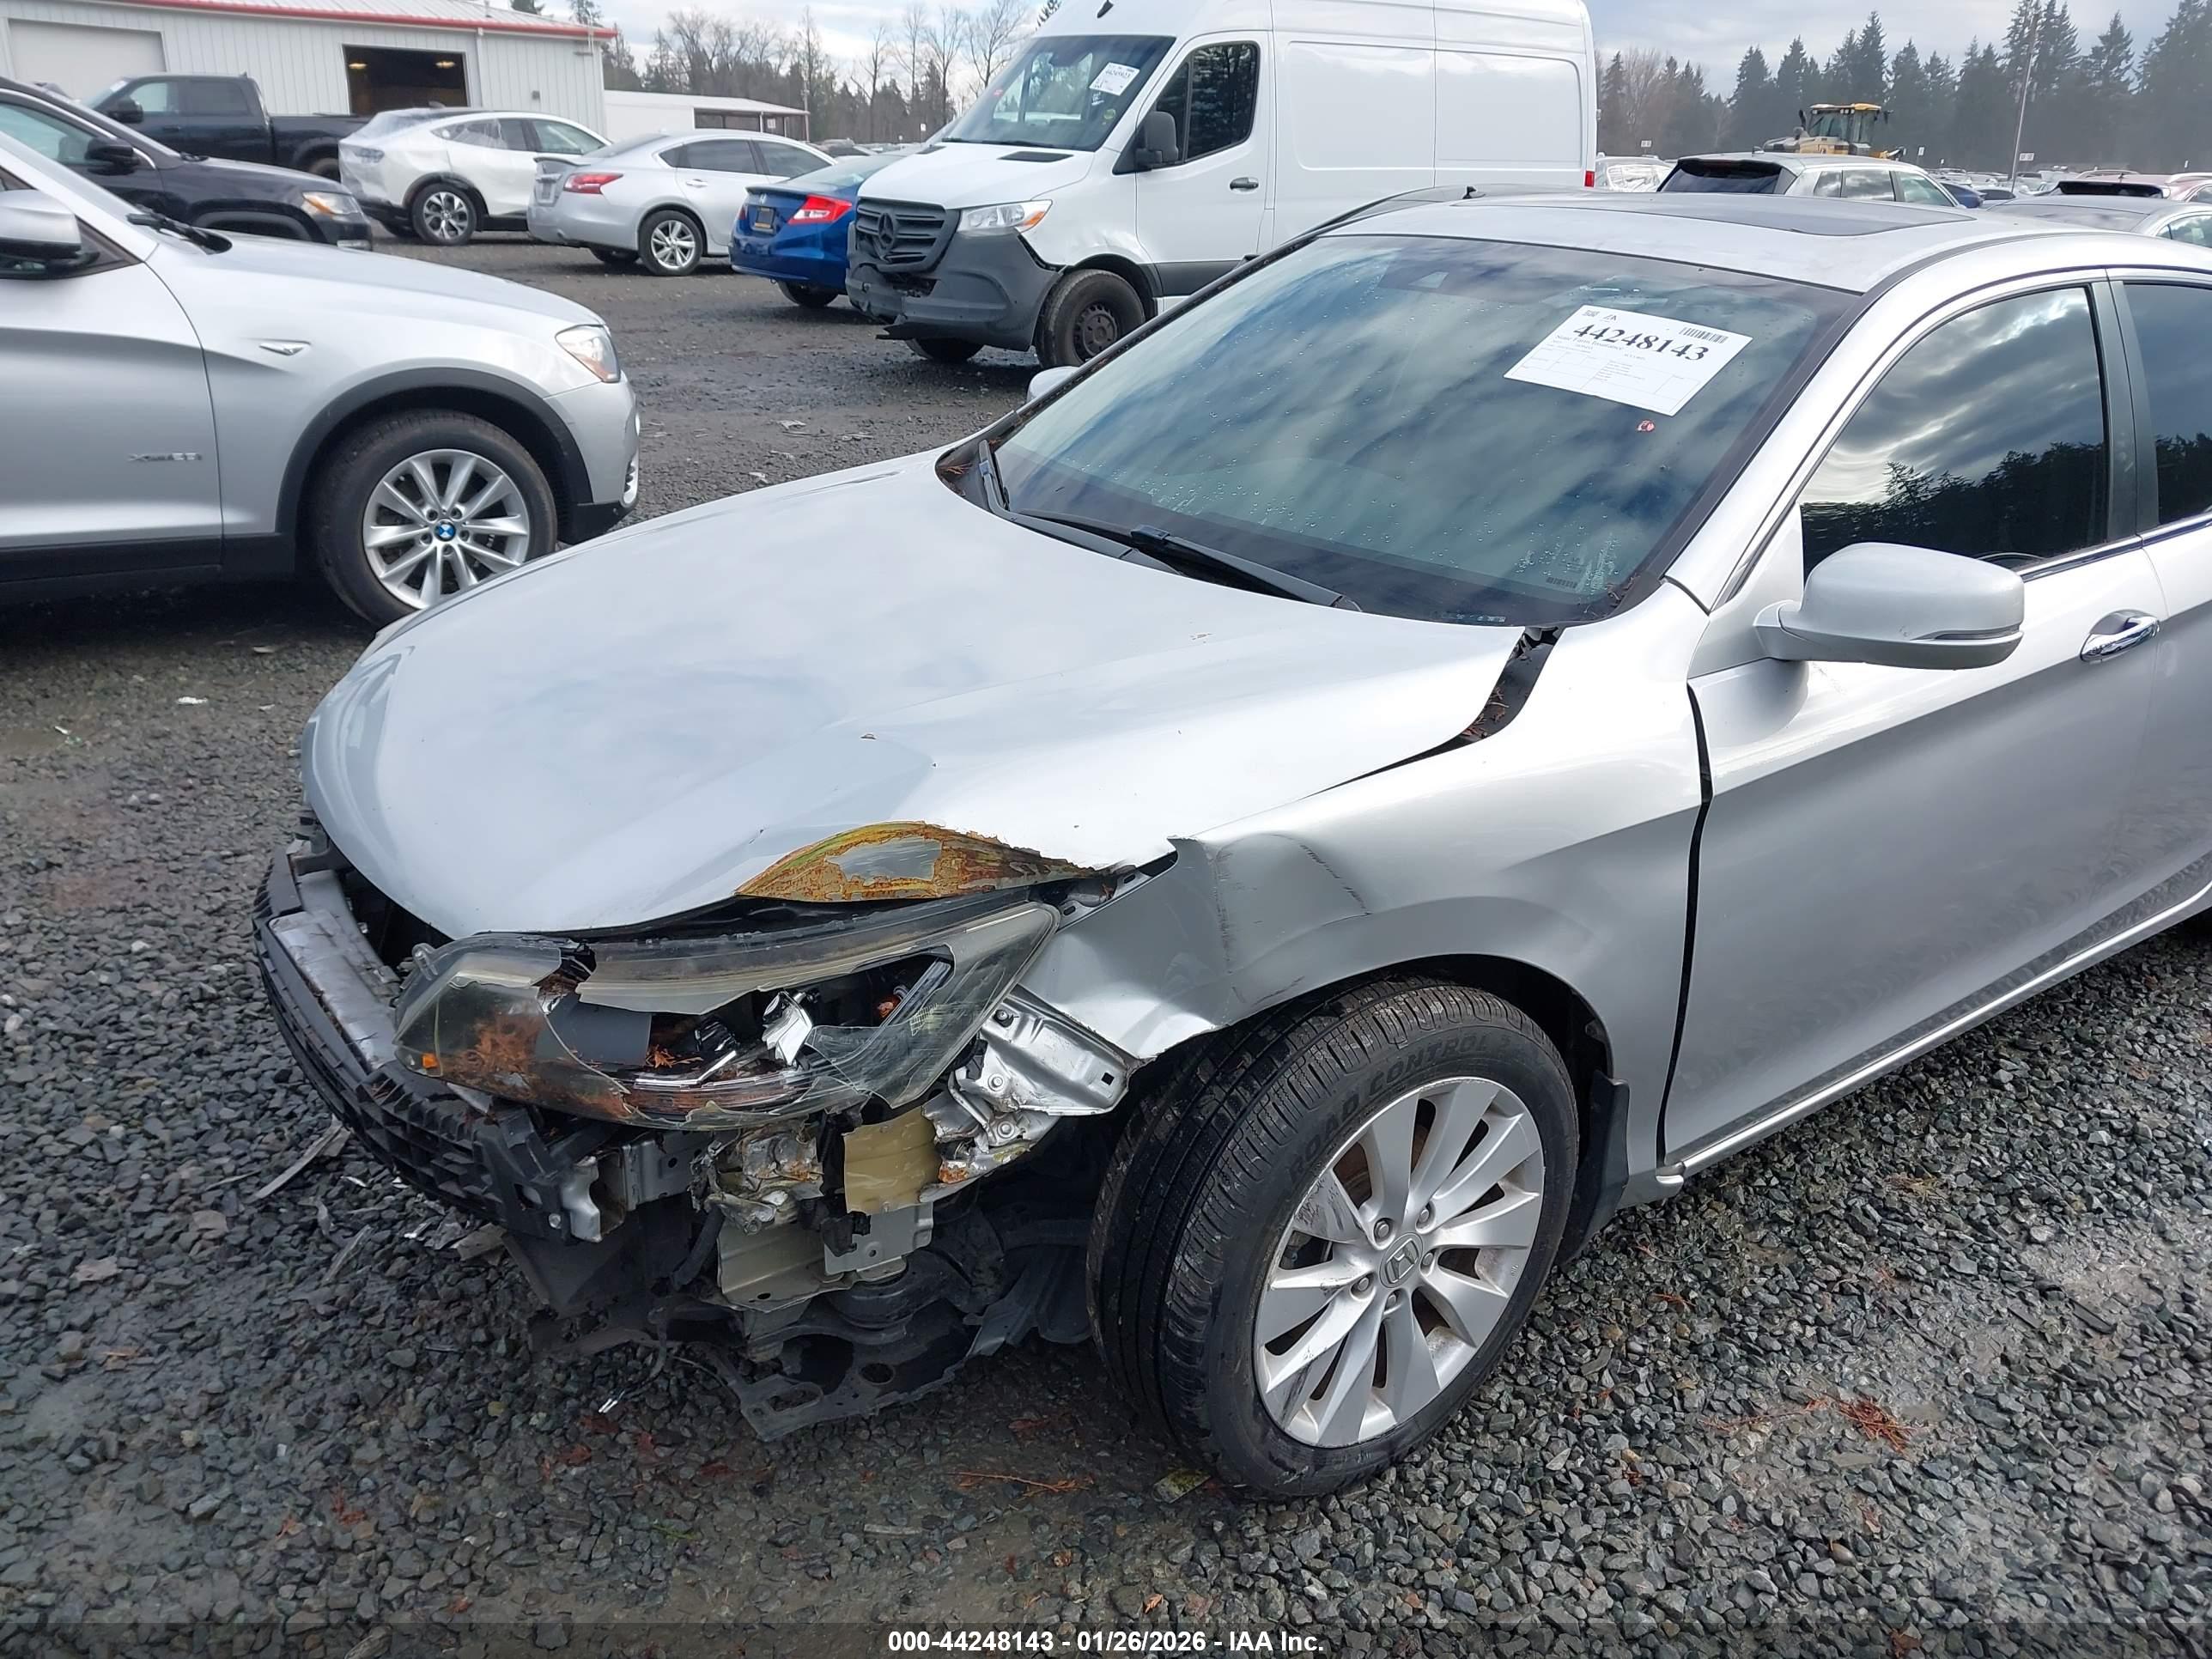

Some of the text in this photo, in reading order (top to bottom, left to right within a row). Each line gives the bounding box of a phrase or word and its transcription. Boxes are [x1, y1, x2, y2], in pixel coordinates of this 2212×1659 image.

[1574, 324, 1709, 361] 44248143
[1288, 1093, 1361, 1184] ROAD
[1370, 1034, 1487, 1097] CONTROL
